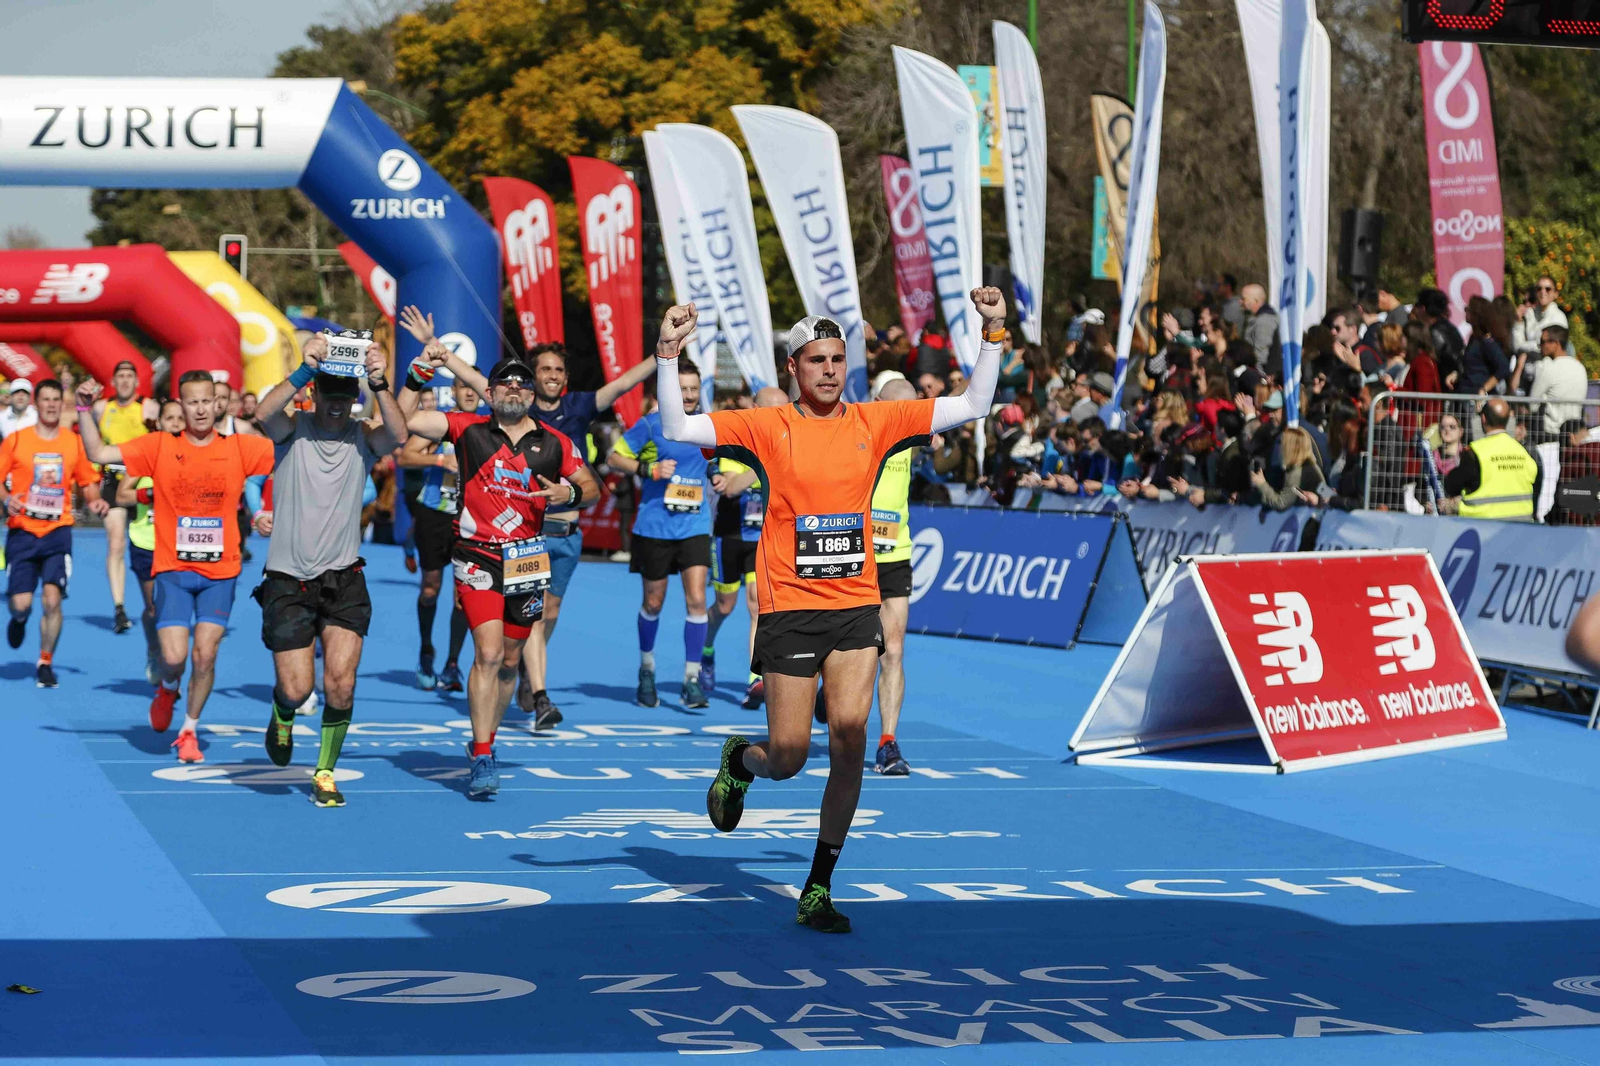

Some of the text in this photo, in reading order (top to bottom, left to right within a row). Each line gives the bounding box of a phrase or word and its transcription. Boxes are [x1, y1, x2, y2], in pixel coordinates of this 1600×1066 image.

[30, 106, 266, 149] ZURICH
[350, 197, 446, 220] ZURICH
[331, 346, 359, 358] 9652
[822, 516, 857, 528] ZURICH
[518, 545, 544, 557] ZURICH
[816, 537, 850, 552] 1869
[516, 561, 540, 573] 4089
[942, 551, 1071, 601] ZURICH
[1477, 562, 1595, 629] ZURICH
[1249, 591, 1324, 687] NB
[1366, 584, 1436, 675] NB
[1264, 702, 1299, 734] new
[1378, 692, 1413, 720] new
[464, 830, 629, 839] new
[609, 876, 1416, 903] ZURICH
[578, 963, 1269, 994] ZURICH
[628, 992, 1341, 1027] MARATÓN
[656, 1016, 1424, 1055] SEVILLA
